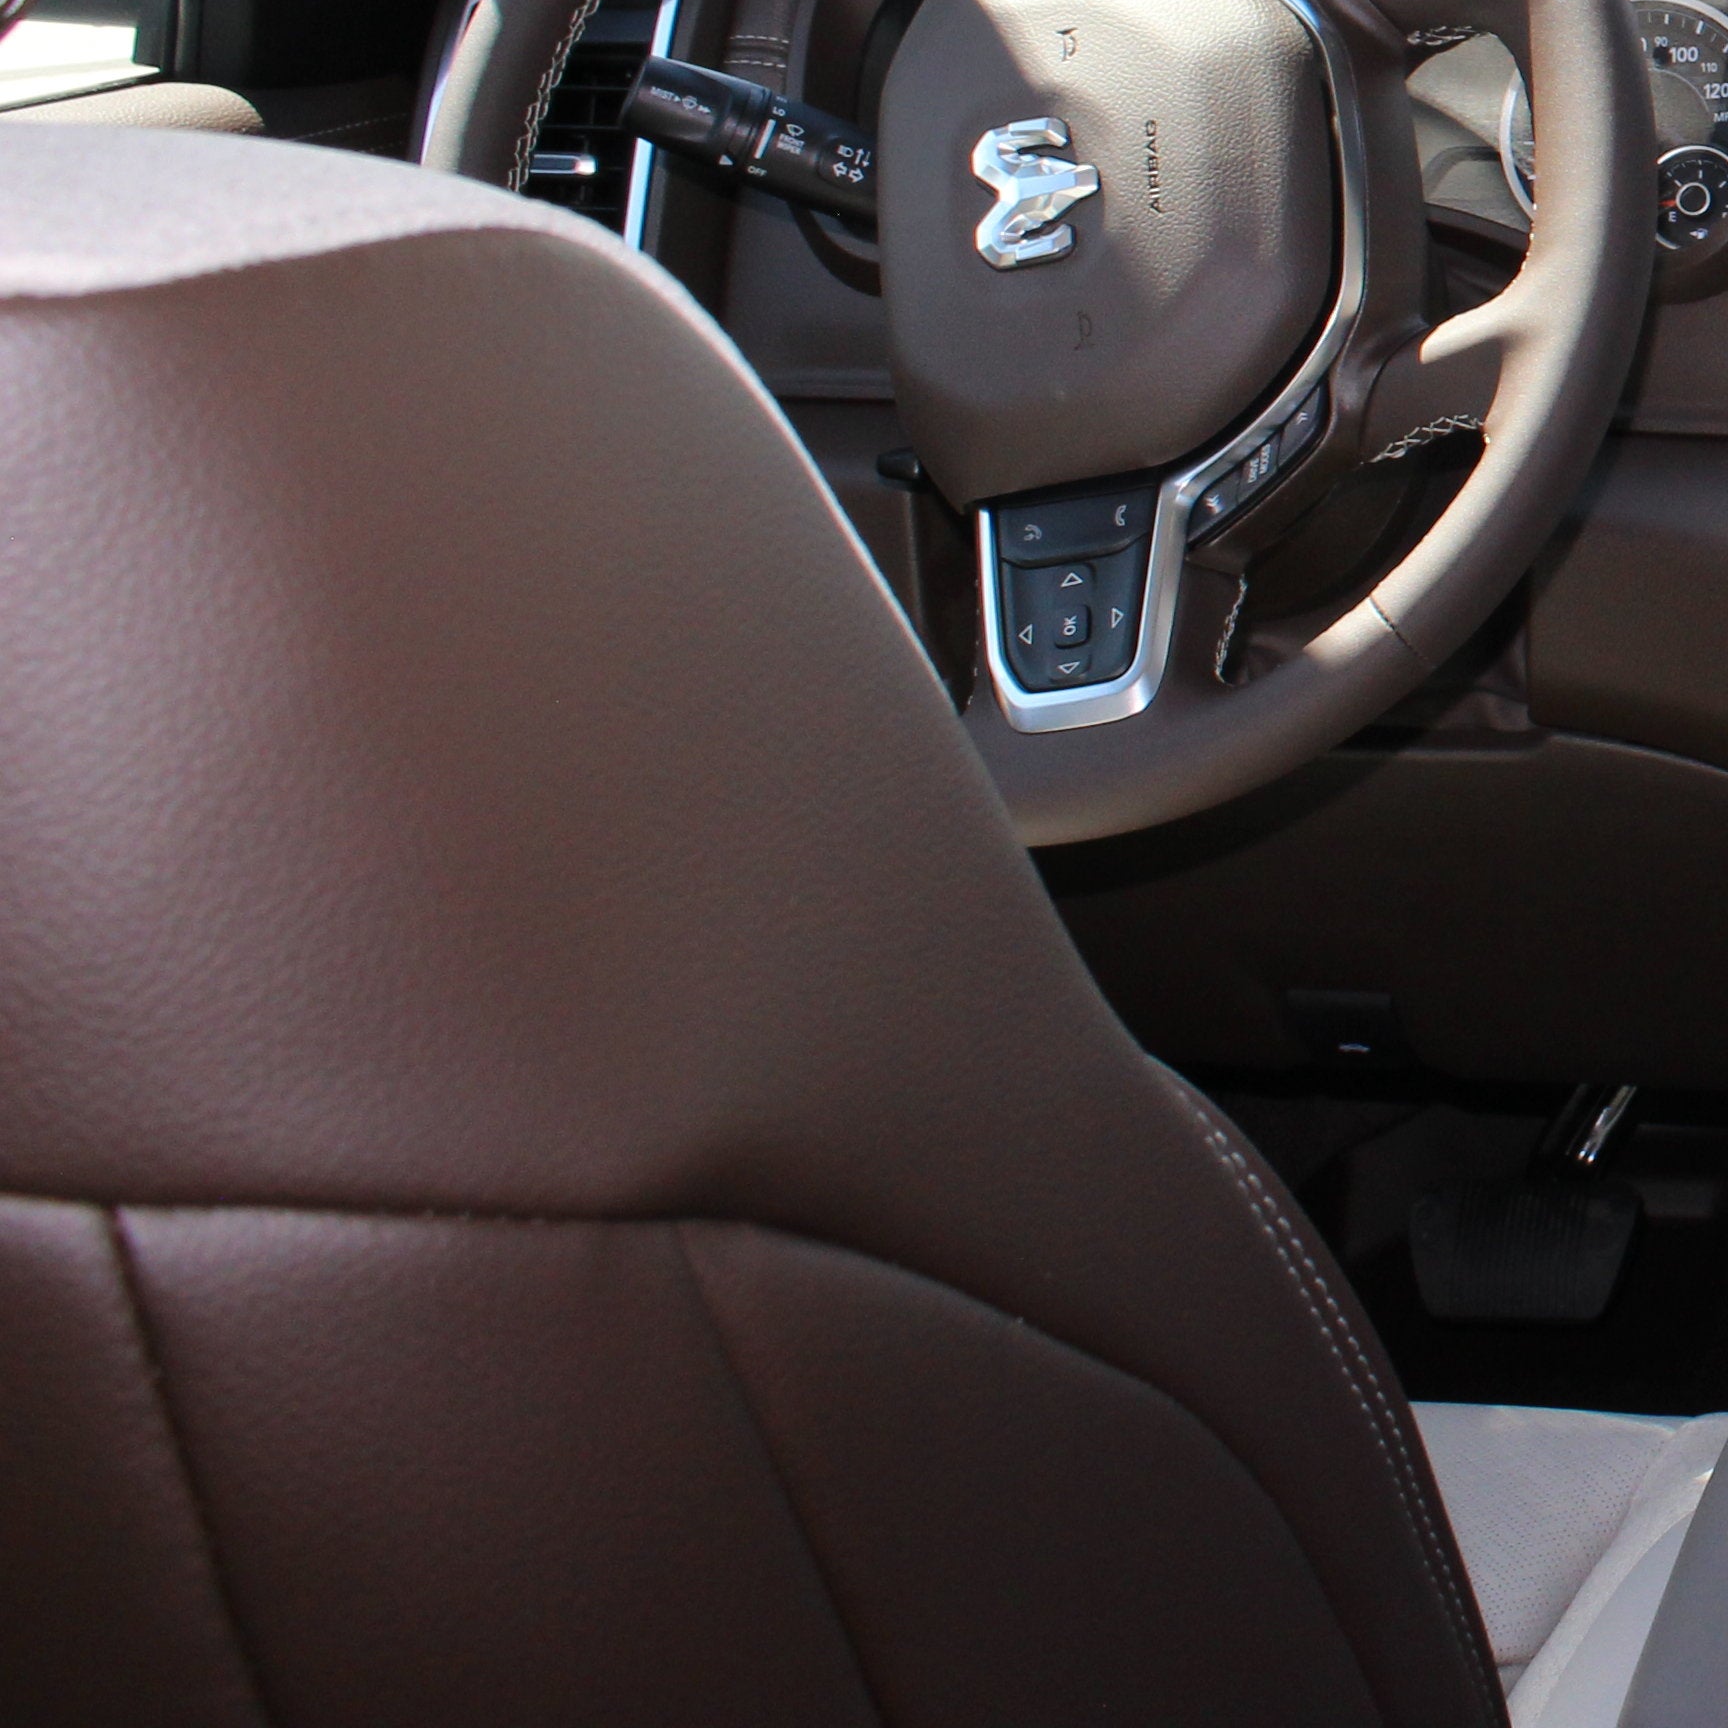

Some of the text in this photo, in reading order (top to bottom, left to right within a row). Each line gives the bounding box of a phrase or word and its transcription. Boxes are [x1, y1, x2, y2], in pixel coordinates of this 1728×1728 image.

[1654, 36, 1669, 47] 90
[1669, 46, 1699, 63] 100
[1701, 62, 1718, 73] 110
[747, 165, 769, 177] OFF
[1145, 120, 1164, 214] AIRBAG
[1668, 211, 1677, 223] E
[1063, 615, 1077, 636] OK
